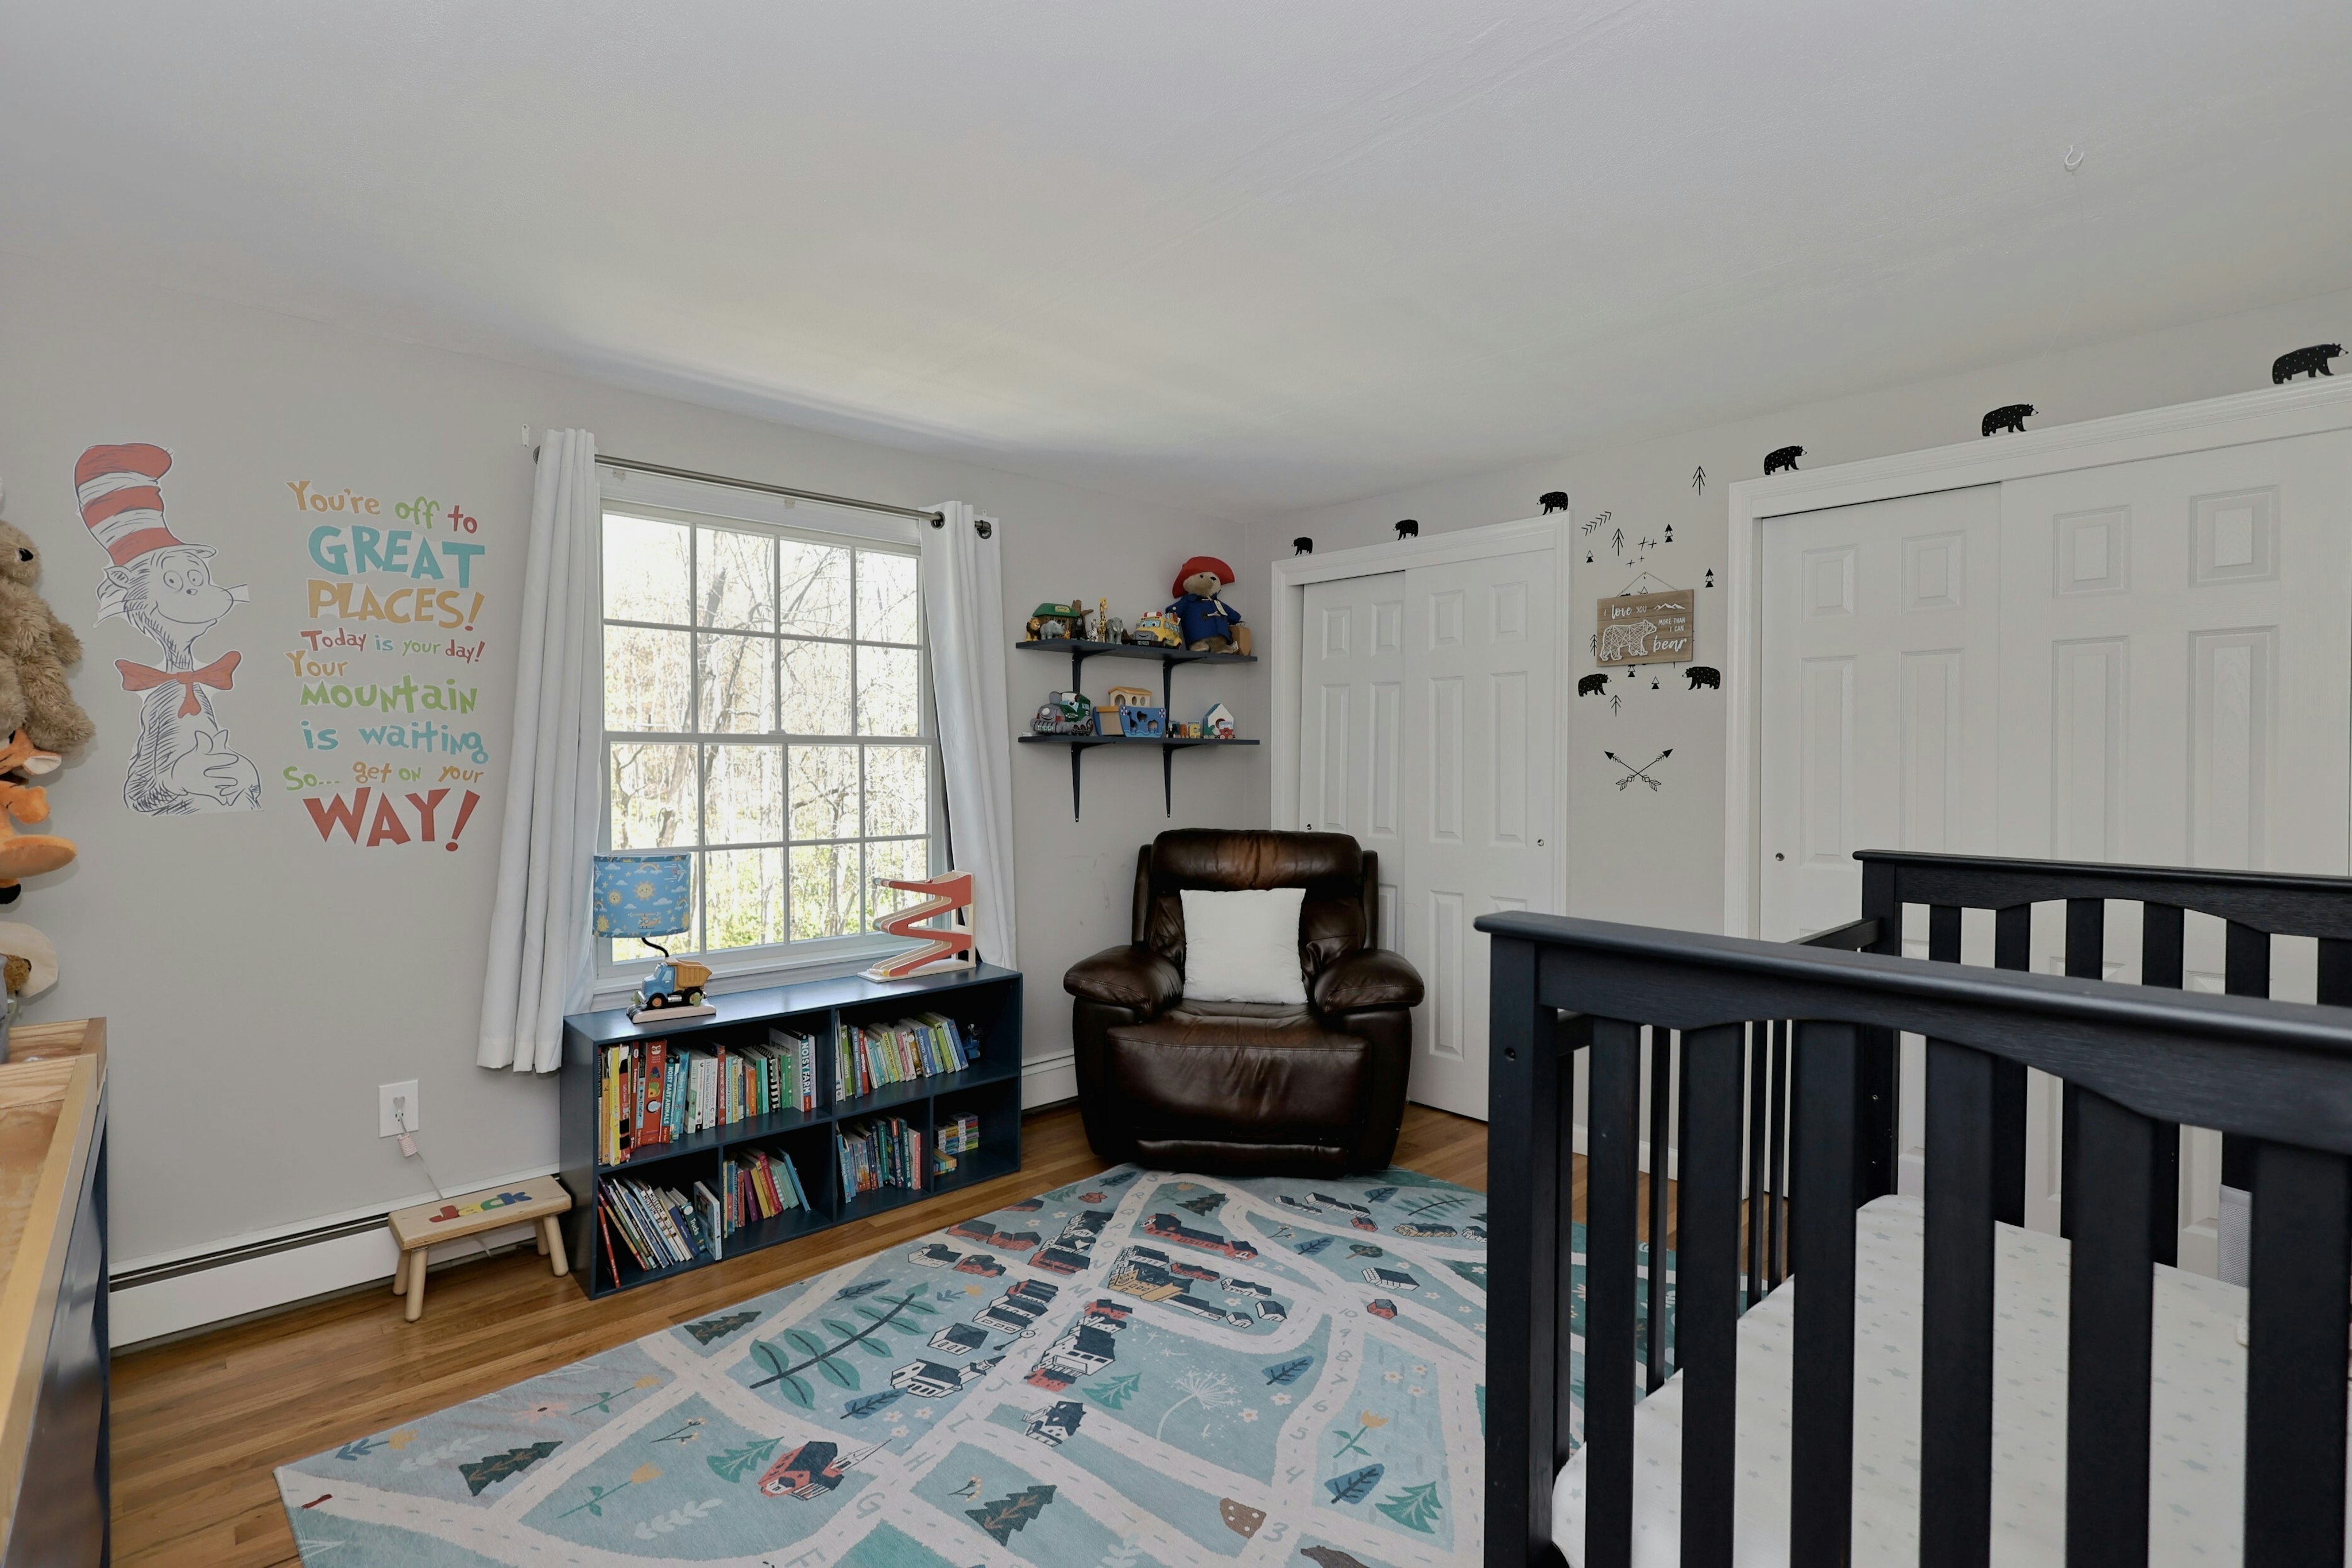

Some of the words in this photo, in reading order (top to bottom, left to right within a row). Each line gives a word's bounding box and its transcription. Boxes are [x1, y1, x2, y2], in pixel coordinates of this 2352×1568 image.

[394, 496, 440, 529] off
[447, 505, 478, 533] to
[308, 525, 485, 589] GREAT
[307, 579, 485, 631] PLACES!
[1611, 604, 1633, 620] love
[300, 628, 367, 652] Today
[374, 635, 394, 652] is
[402, 638, 442, 656] your
[445, 640, 485, 664] day!
[1653, 635, 1687, 653] bear
[285, 650, 347, 677] Your
[300, 721, 339, 750] is
[352, 761, 392, 784] get
[438, 765, 483, 784] your
[302, 786, 481, 852] WAY!
[801, 1042, 810, 1069] NOISY
[802, 1070, 811, 1093] FARM
[642, 1194, 657, 1215] MUSEUM
[649, 1193, 664, 1213] MUSEUM
[688, 1217, 701, 1236] Trucks
[1109, 1223, 1125, 1231] P
[1068, 1284, 1092, 1298] M
[1340, 1329, 1351, 1338] 9
[1017, 1344, 1037, 1358] K
[1336, 1350, 1352, 1361] 8
[985, 1377, 1012, 1392] J
[1331, 1373, 1348, 1385] 7
[1313, 1400, 1328, 1412] 6
[1289, 1427, 1309, 1441] 5
[903, 1451, 937, 1473] H
[1285, 1466, 1305, 1484] 4
[856, 1492, 885, 1520] G
[1263, 1522, 1289, 1542] 3
